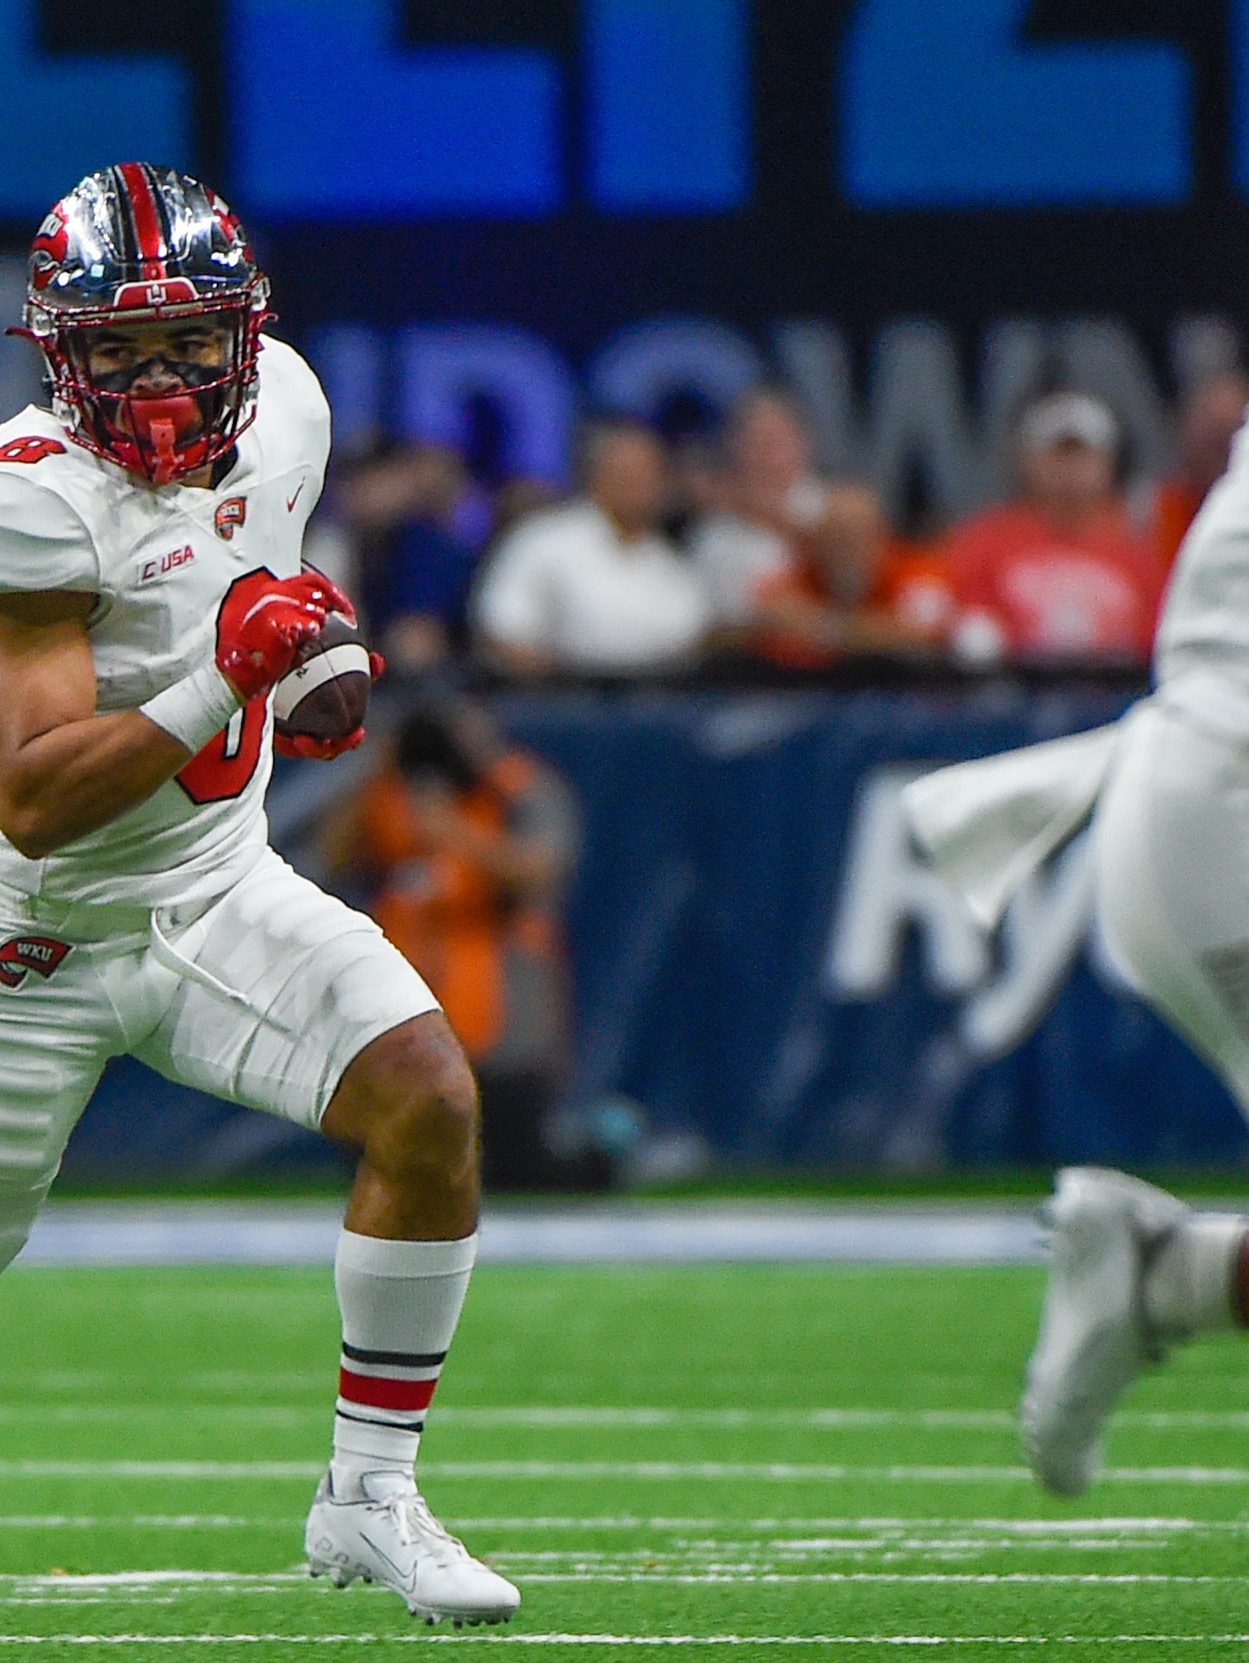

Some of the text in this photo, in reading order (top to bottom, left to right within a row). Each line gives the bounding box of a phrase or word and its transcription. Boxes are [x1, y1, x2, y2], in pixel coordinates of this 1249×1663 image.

[141, 544, 196, 581] C USA
[17, 942, 54, 962] WKU
